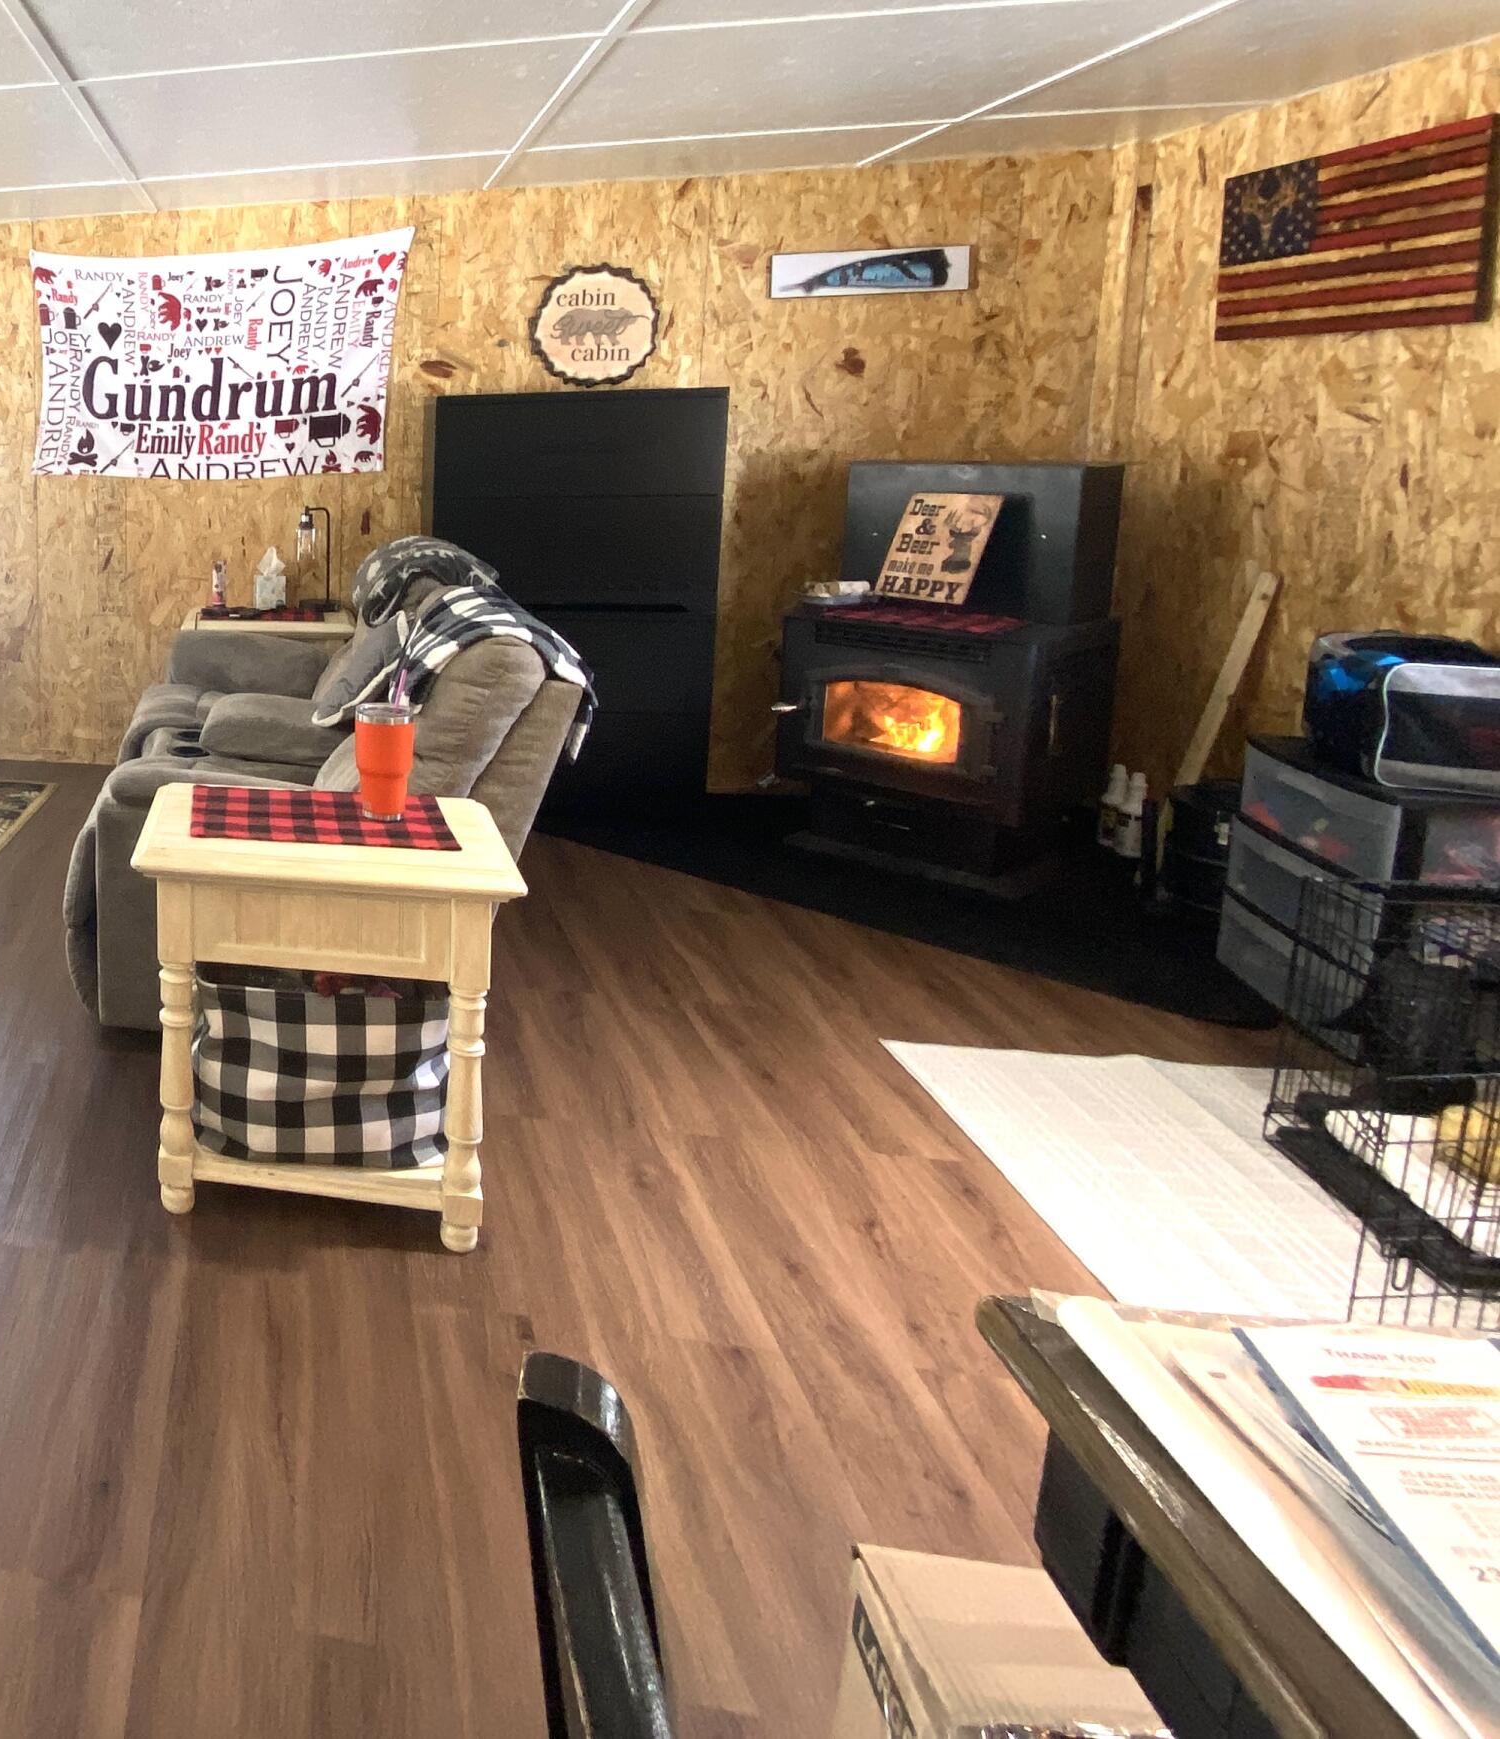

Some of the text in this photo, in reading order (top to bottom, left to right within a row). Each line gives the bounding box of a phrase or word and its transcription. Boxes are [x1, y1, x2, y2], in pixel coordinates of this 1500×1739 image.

[75, 269, 124, 281] RANDY
[51, 287, 78, 306] Randy
[183, 294, 224, 303] RANDY
[556, 288, 616, 307] cabin
[234, 295, 245, 327] JOEY
[267, 265, 303, 364] JOEY
[297, 282, 316, 362] ANDREW
[313, 285, 333, 351] RANDY
[328, 272, 355, 369] ANDREW
[42, 328, 91, 348] JOEY
[122, 287, 136, 365] ANDREW
[137, 331, 177, 341] RANDY
[244, 317, 263, 351] Randy
[359, 310, 382, 348] Randy
[168, 343, 191, 360] Joey
[184, 335, 245, 347] ANDREW
[571, 344, 630, 361] cabin
[69, 347, 83, 412] RANDY
[82, 355, 337, 422] Gundrum
[59, 415, 76, 460] RANDY
[135, 421, 267, 460] Emily Randy
[150, 456, 319, 480] ANDREW
[915, 518, 936, 535] &
[880, 575, 966, 600] HAPPY
